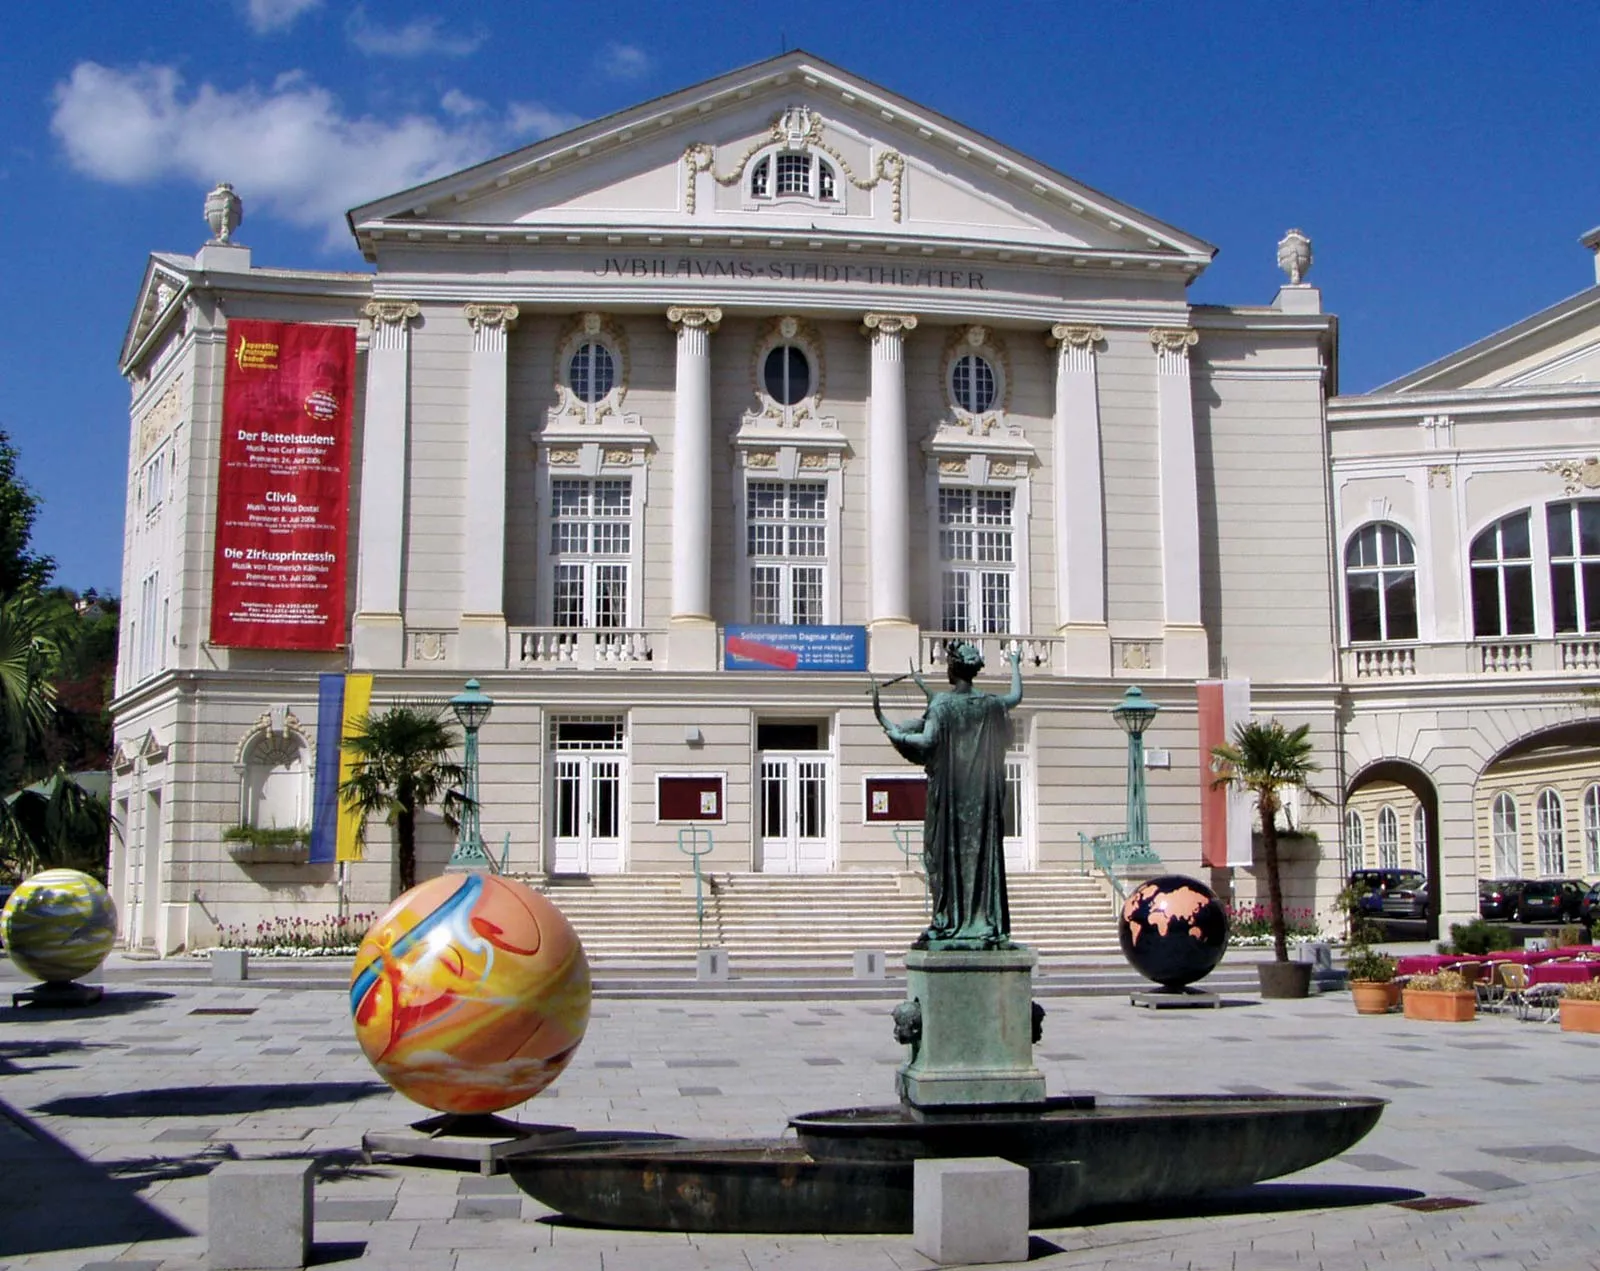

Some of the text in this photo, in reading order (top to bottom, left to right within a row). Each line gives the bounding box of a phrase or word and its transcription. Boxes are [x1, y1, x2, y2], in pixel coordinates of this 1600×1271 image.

[238, 430, 335, 445] Der Bettelstudent
[265, 491, 297, 503] Clivia
[224, 548, 335, 563] Die Zirkusprinzessin
[799, 632, 828, 642] Dagmar
